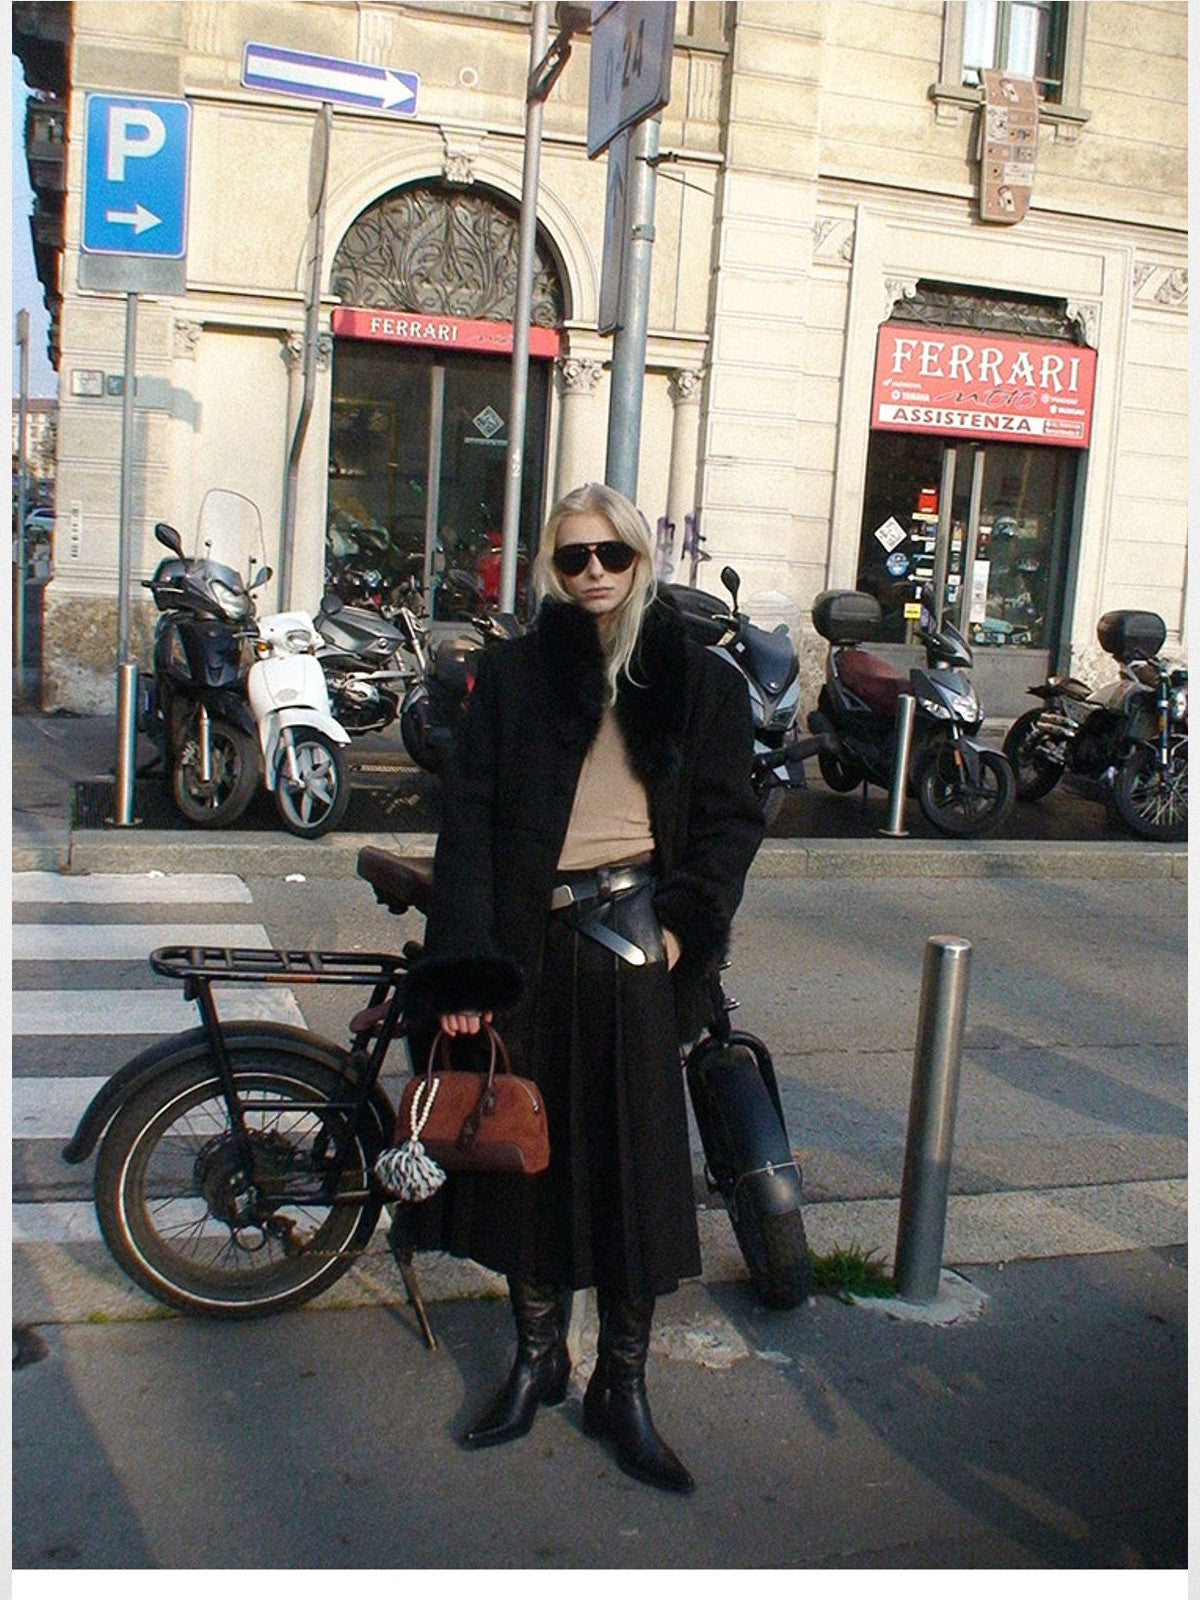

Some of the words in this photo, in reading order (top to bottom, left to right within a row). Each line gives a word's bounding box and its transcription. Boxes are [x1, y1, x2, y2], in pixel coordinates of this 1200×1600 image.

[106, 107, 167, 182] P
[371, 317, 457, 341] FERRARI
[892, 338, 1081, 392] FERRARI
[893, 408, 1032, 431] ASSISTENZA
